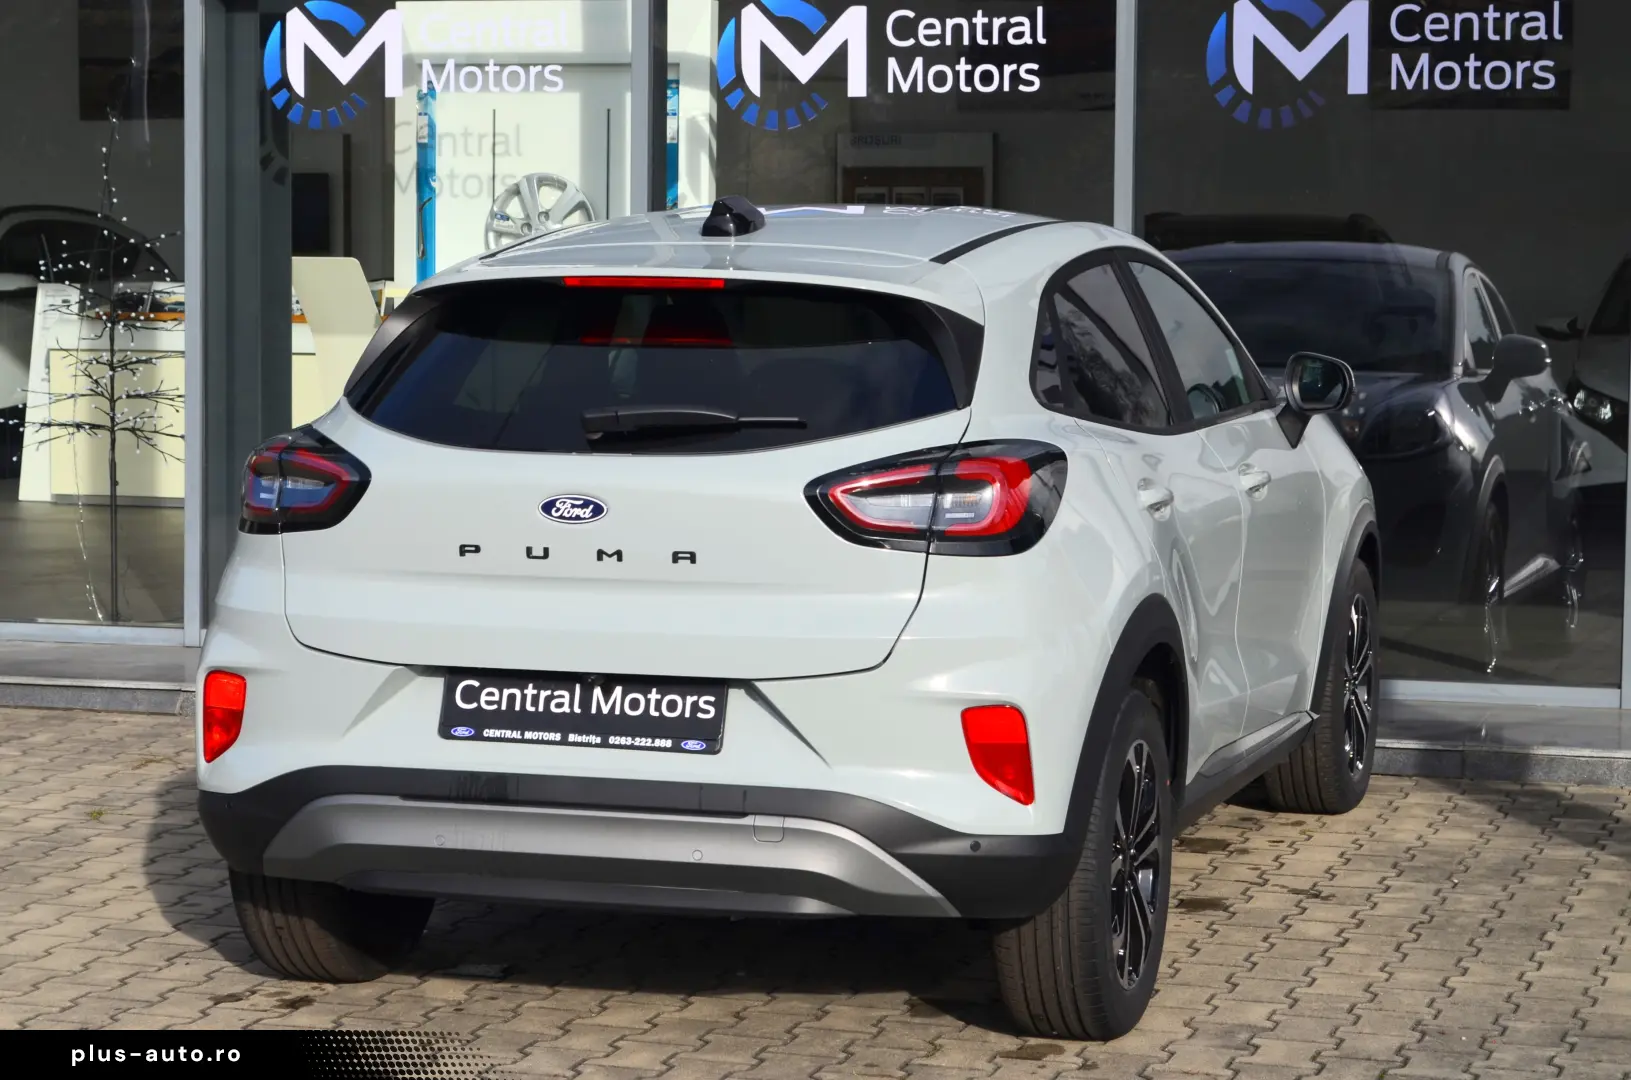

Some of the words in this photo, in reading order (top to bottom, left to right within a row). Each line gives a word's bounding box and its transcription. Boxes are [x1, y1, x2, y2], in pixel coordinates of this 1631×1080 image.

[420, 11, 568, 48] Central
[886, 5, 1047, 47] Central
[1389, 1, 1563, 42] Central
[421, 58, 563, 93] Motors
[886, 56, 1041, 94] Motors
[1390, 53, 1556, 91] Motors
[551, 498, 593, 520] Ford
[459, 543, 697, 564] PUMA
[455, 679, 581, 714] Central
[590, 685, 716, 719] Motors
[483, 729, 522, 739] CENTRAL
[524, 731, 561, 741] MOTORS
[609, 736, 672, 748] 0263-222.888
